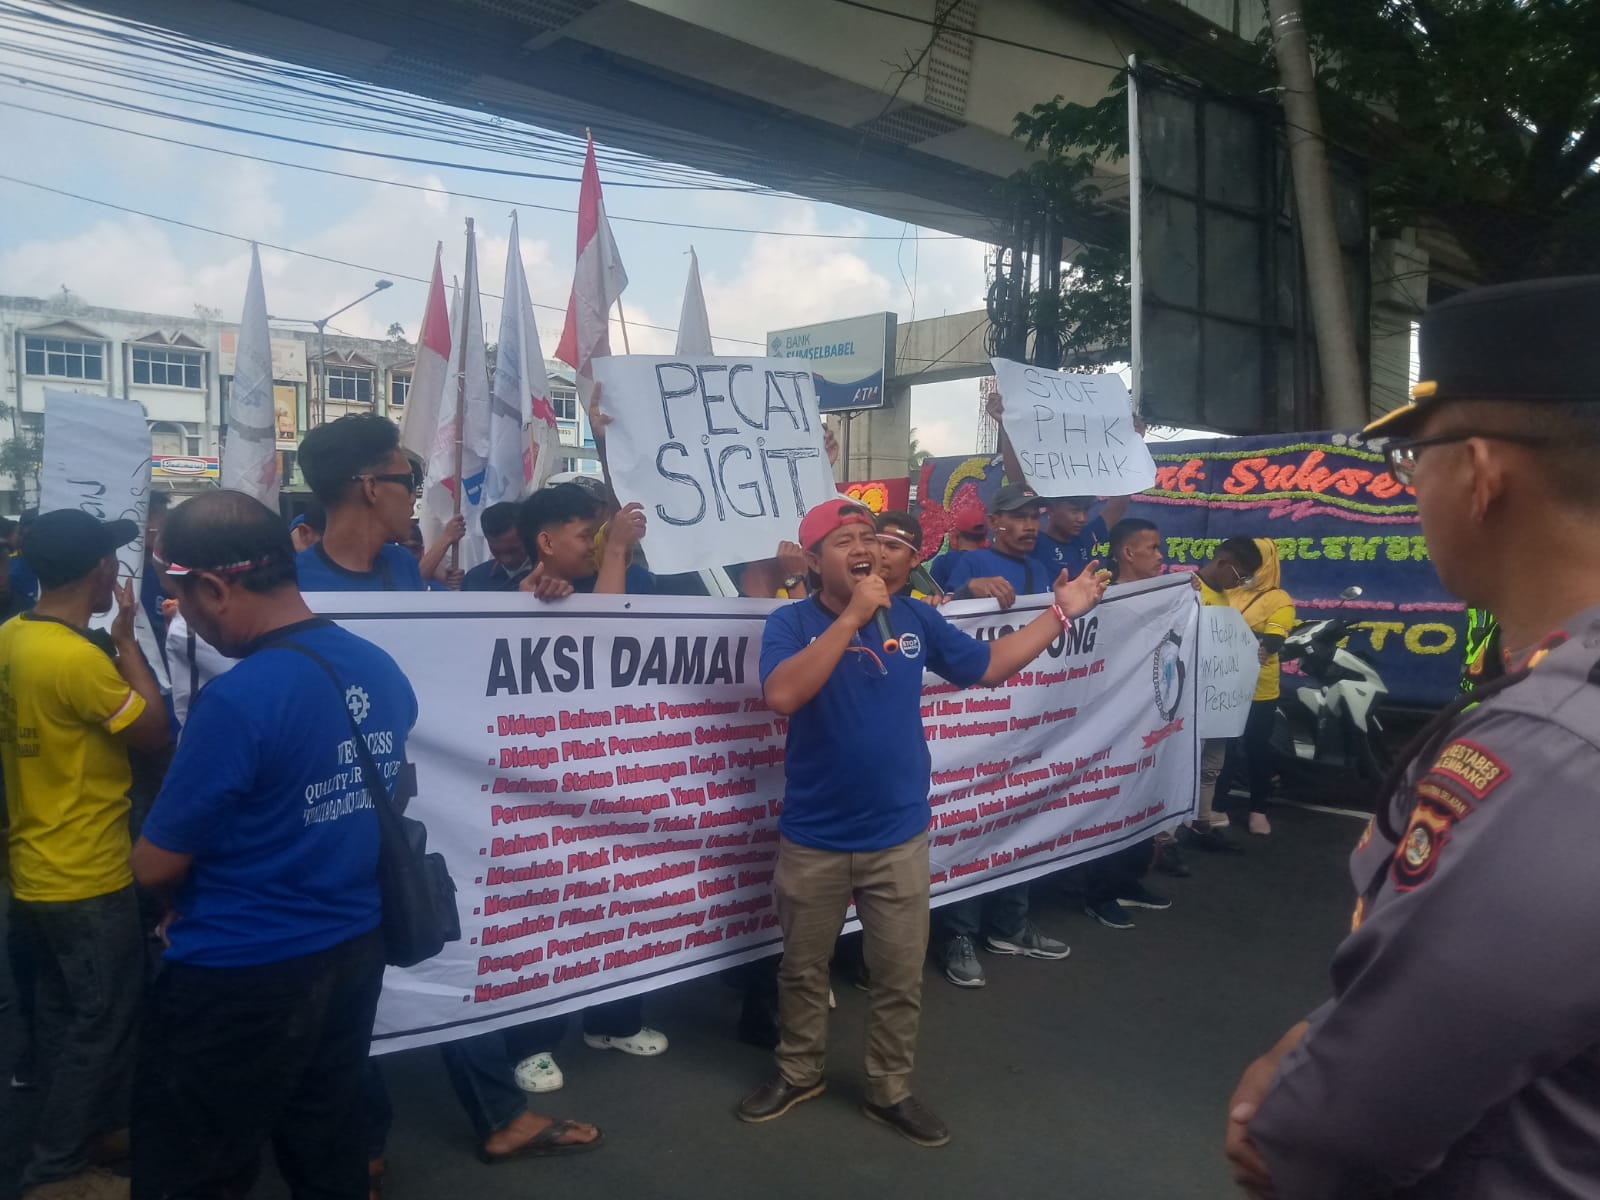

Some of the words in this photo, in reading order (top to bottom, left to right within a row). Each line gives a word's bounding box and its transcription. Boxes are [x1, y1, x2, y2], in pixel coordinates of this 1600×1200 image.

[786, 333, 811, 349] BANK
[655, 362, 812, 439] PECAT
[853, 386, 879, 403] ATM
[1032, 404, 1126, 448] PHK
[1020, 451, 1142, 481] SEPIHAK
[1223, 449, 1419, 499] Sukse
[486, 635, 595, 697] AKSI
[611, 636, 749, 688] DAMAI
[497, 714, 556, 738] Diduga
[559, 708, 612, 730] Bahwa
[614, 703, 656, 725] Pihak
[658, 698, 741, 721] Perusahaan
[500, 745, 559, 769] Diduga
[561, 738, 607, 761] Pihak
[609, 731, 693, 756] Perusahaan
[695, 722, 773, 745] Sebelumnya
[936, 700, 963, 716] Libur
[965, 695, 1012, 713] Nasional
[492, 777, 559, 794] Bahwa
[562, 770, 614, 793] Status
[616, 761, 687, 785] Hubungan
[689, 752, 726, 776] Kerja
[491, 800, 586, 826] Perundang
[589, 793, 670, 815] Undangan
[671, 787, 706, 806] Yang
[706, 778, 756, 800] Berlaku
[491, 832, 549, 857] Bahwa
[552, 821, 649, 846] Perusahaan
[653, 815, 696, 832] Tidak
[698, 805, 767, 829] Membayar
[486, 858, 563, 886] Meminta
[567, 847, 610, 874] Pihak
[613, 838, 703, 863] Perusahaan
[705, 831, 750, 849] Untuk
[481, 915, 555, 946] Meminta
[558, 904, 606, 928] Pihak
[608, 888, 696, 918] Perusahaan
[697, 874, 736, 899] Untuk
[484, 888, 559, 916] Meminta
[563, 877, 611, 902] Pihak
[613, 860, 696, 890] Perusahaan
[474, 973, 550, 1003] Meminta
[552, 957, 601, 984] Untuk
[603, 939, 683, 970] Dihadirkan
[685, 926, 724, 949] Pihak
[477, 947, 543, 975] Dengan
[547, 928, 625, 959] Peraturan
[627, 910, 706, 938] Perundang
